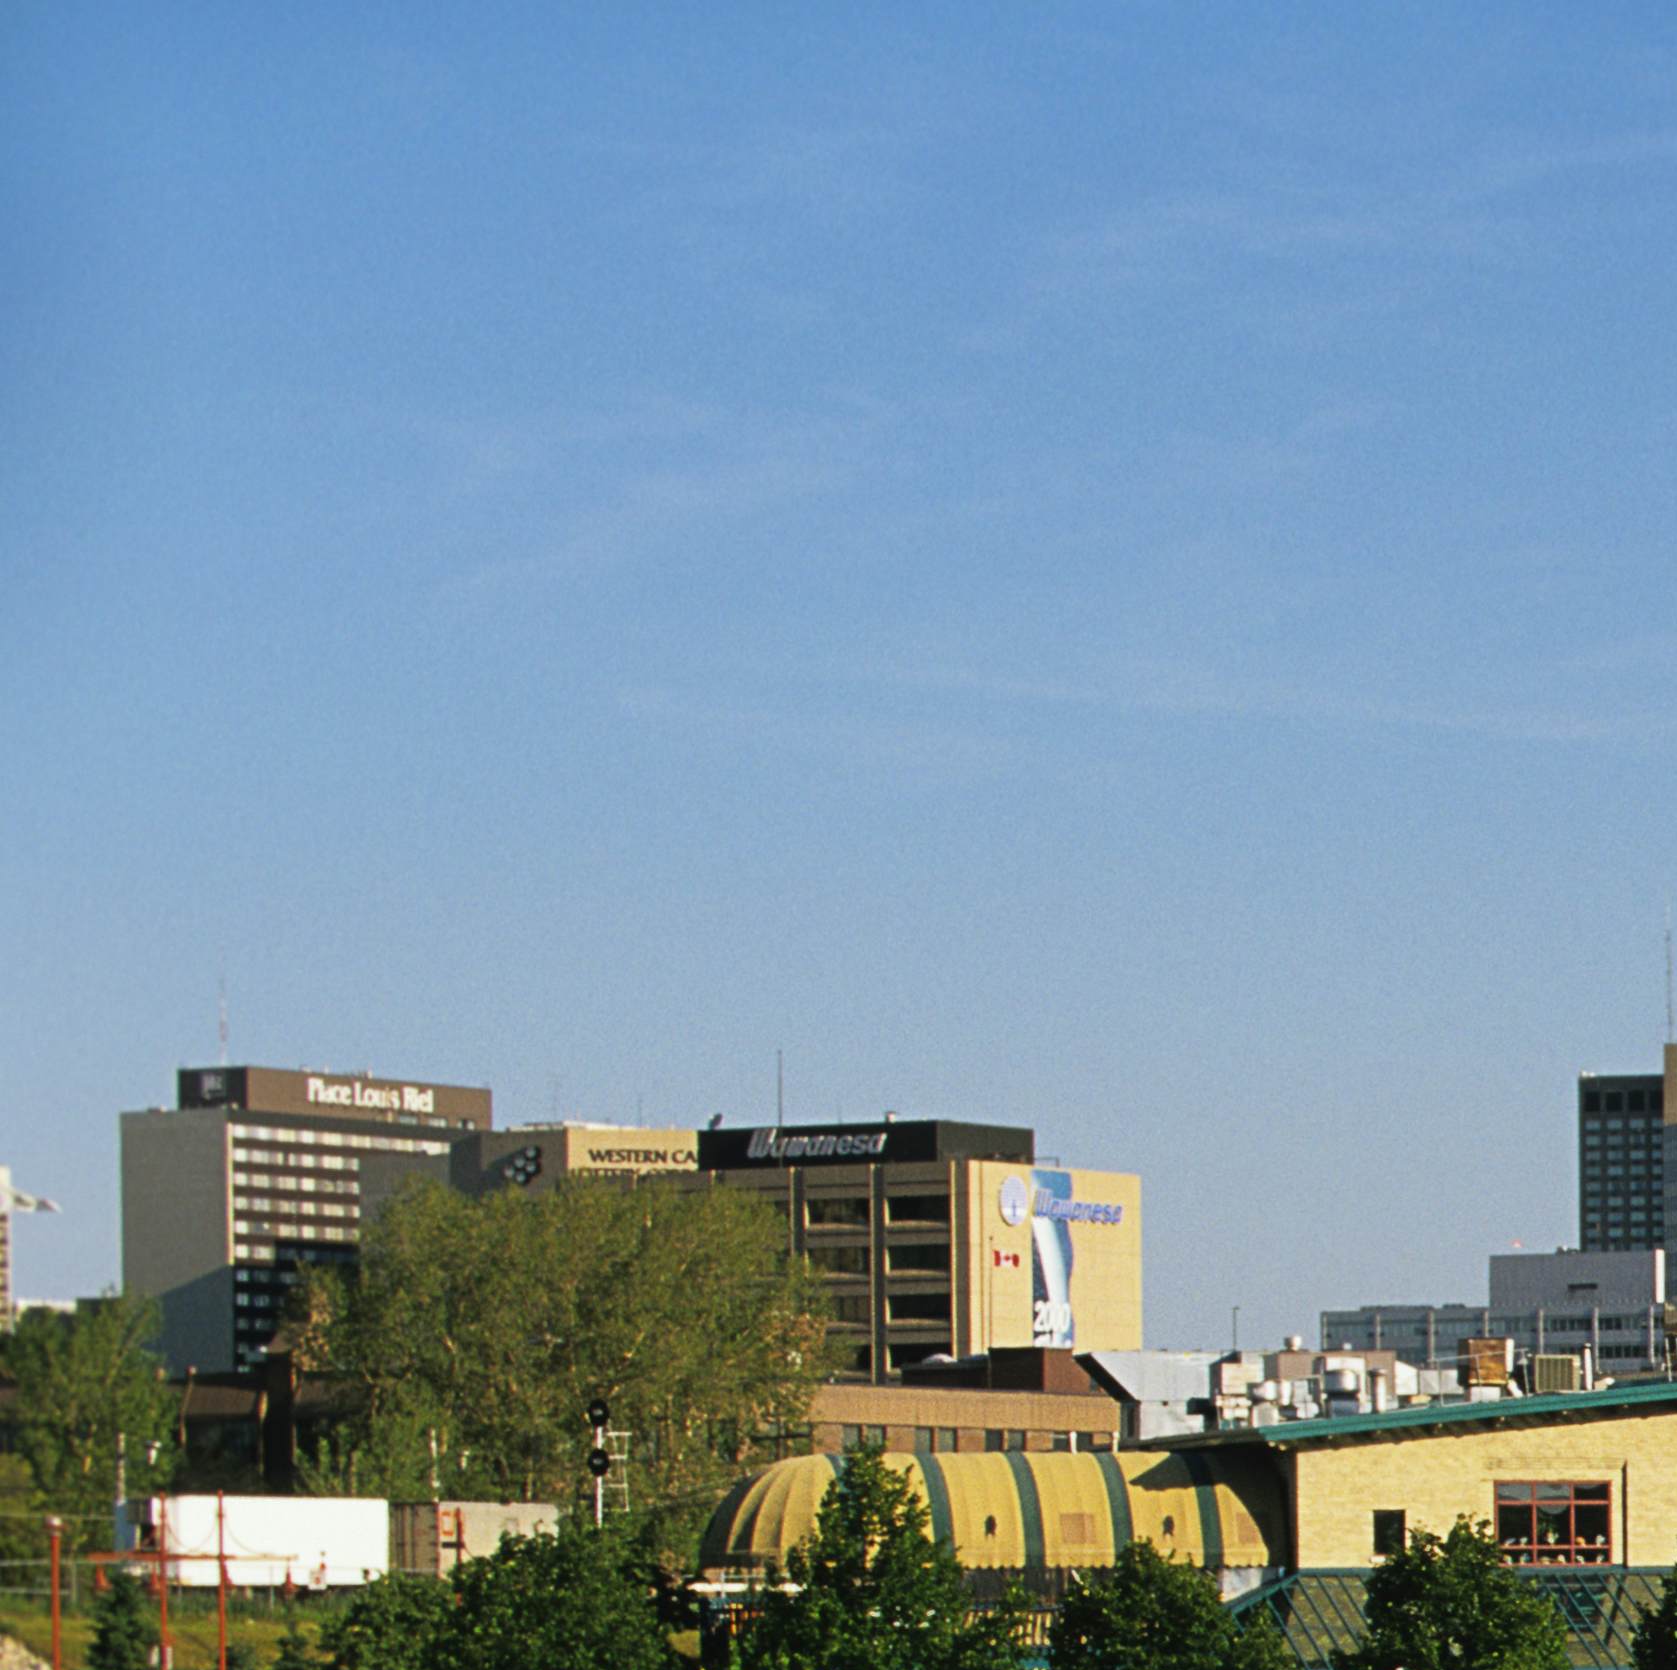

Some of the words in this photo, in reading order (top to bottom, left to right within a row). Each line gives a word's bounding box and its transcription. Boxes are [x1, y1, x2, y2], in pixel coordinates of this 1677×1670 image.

[307, 1077, 352, 1105] Place
[354, 1081, 400, 1109] Louis
[402, 1085, 434, 1114] Riel
[588, 1149, 668, 1164] WESTERN
[747, 1127, 888, 1159] Wawanesa
[1034, 1188, 1123, 1223] Wawanesa
